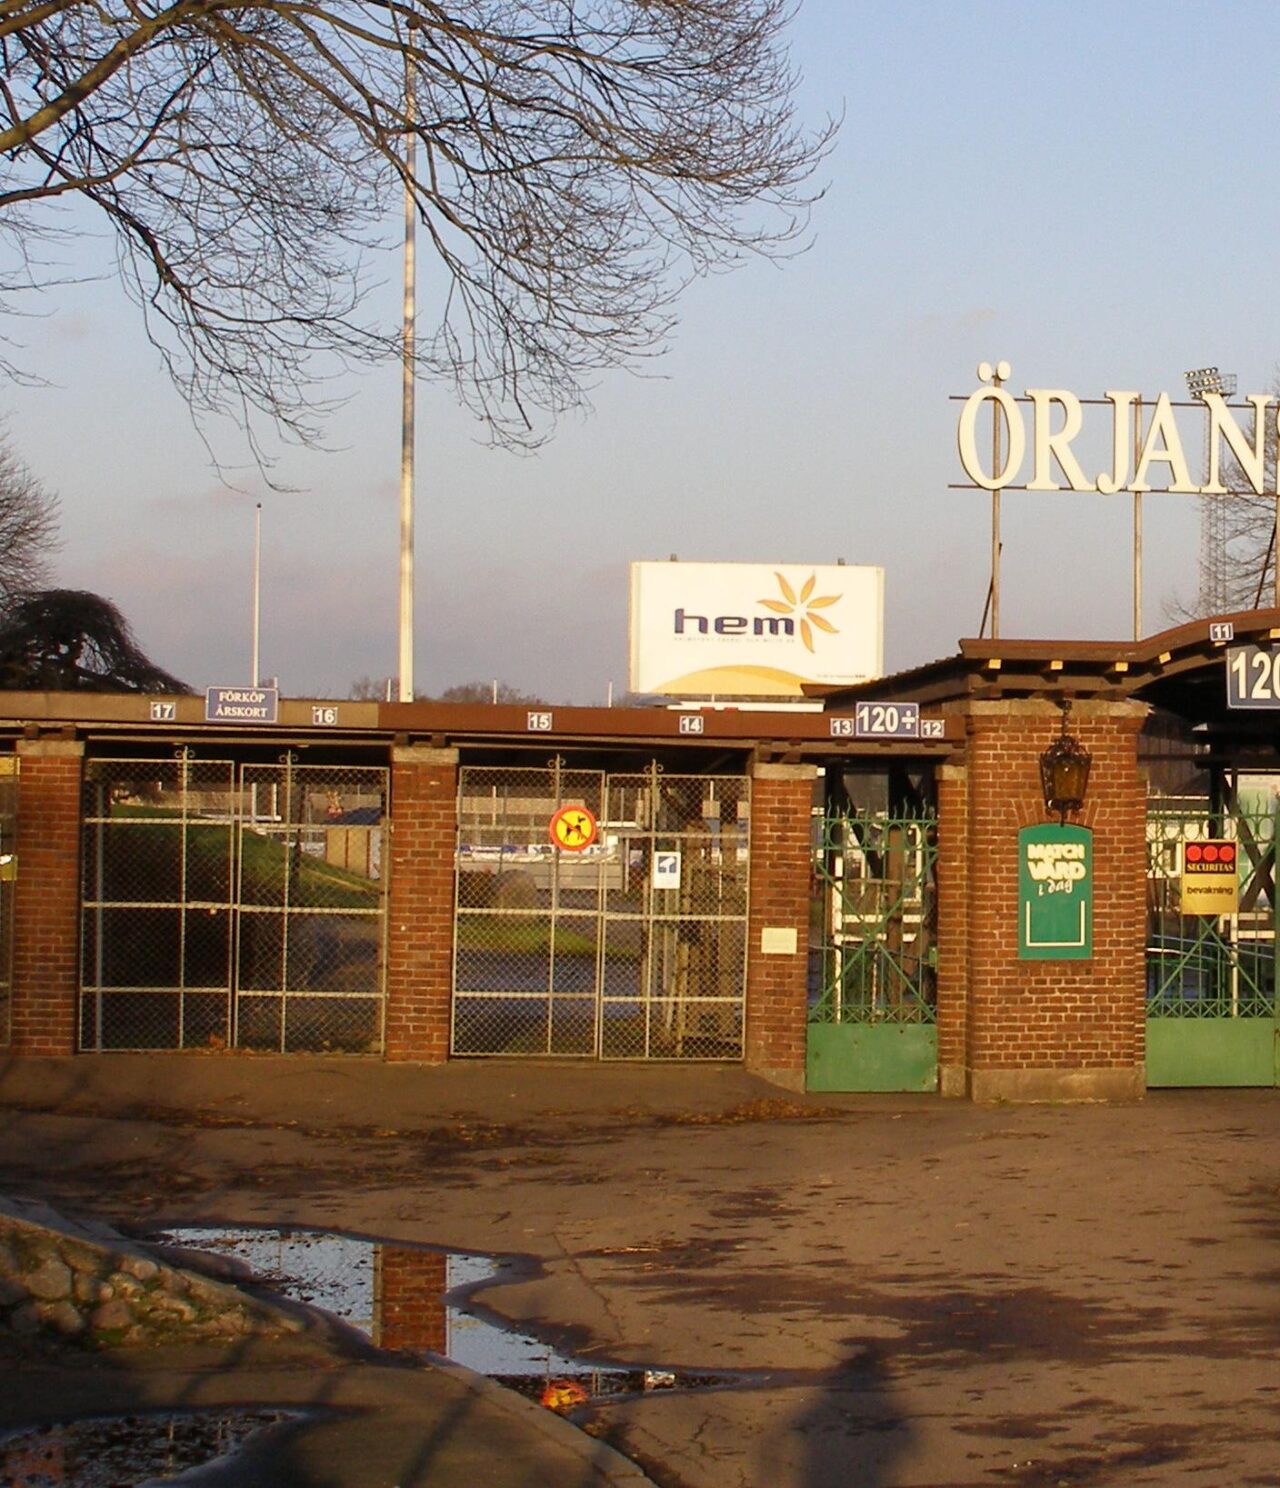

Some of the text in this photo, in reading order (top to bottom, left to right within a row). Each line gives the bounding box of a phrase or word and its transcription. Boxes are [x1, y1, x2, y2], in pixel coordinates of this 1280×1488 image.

[674, 608, 795, 636] hem
[1214, 625, 1230, 638] 11
[219, 691, 265, 703] FÖRKÖP
[153, 704, 173, 719] 17
[215, 704, 268, 718] ÅRSKORT
[316, 709, 335, 723] 16
[530, 715, 549, 729] 15
[682, 718, 701, 732] 14
[833, 720, 851, 734] 13
[923, 722, 942, 736] 12
[1027, 844, 1085, 859] MATCH
[1187, 863, 1234, 872] SECURITAS
[1187, 886, 1233, 895] bevakning
